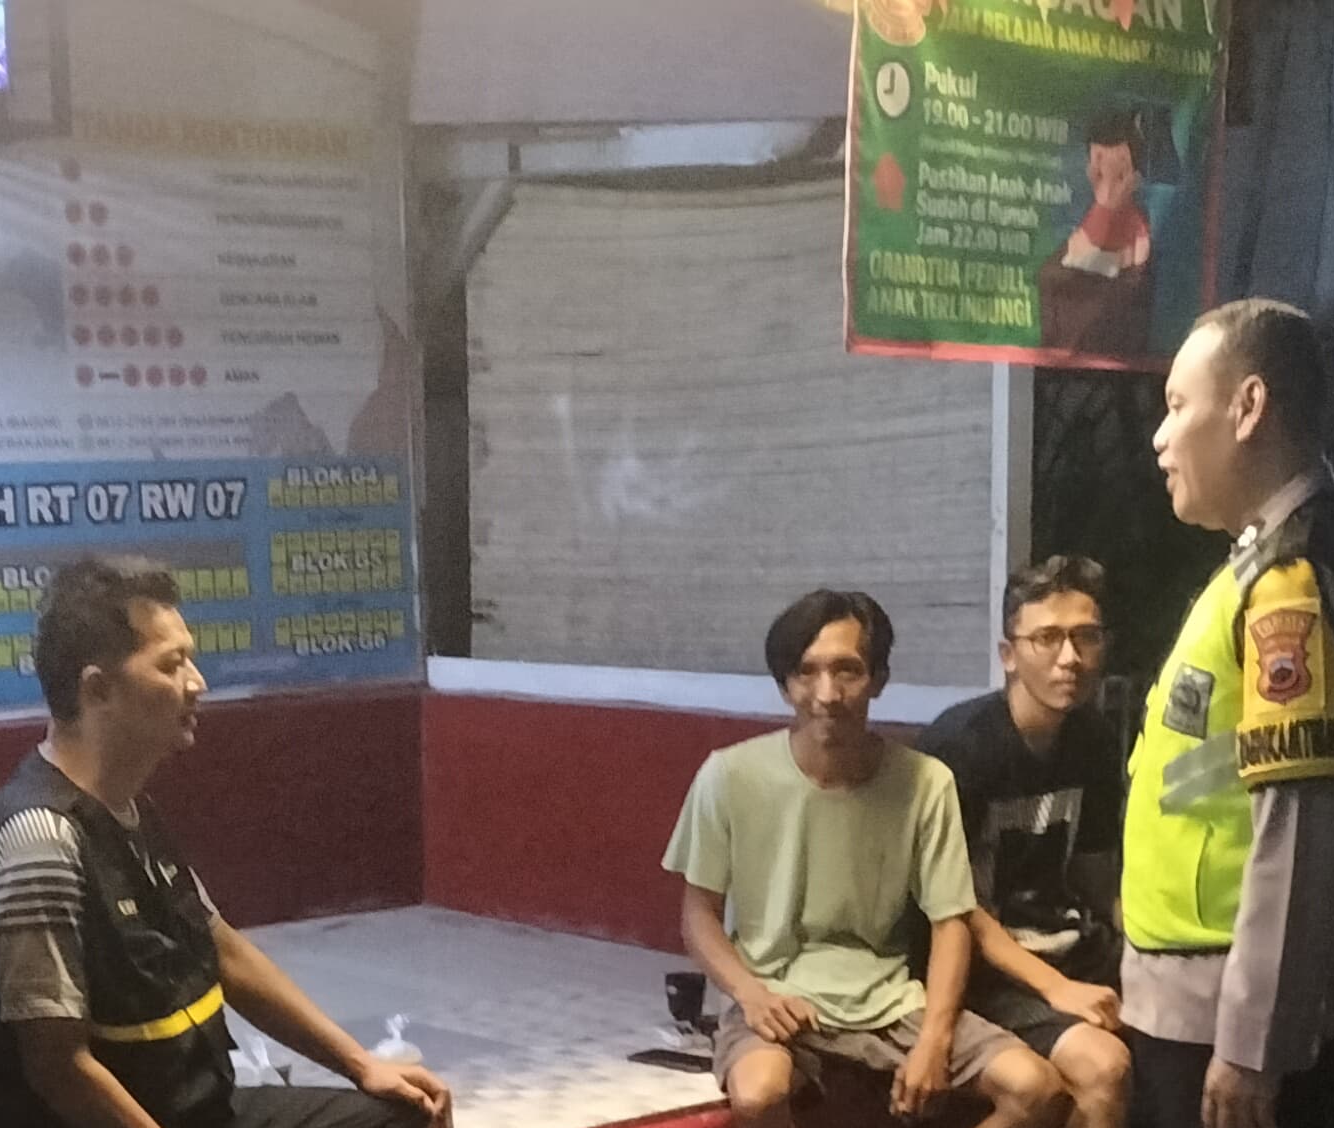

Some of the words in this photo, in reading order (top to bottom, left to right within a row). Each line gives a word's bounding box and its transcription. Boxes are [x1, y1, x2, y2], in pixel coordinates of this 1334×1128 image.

[982, 8, 1055, 49] BELAJAR
[924, 61, 979, 99] Pukul
[984, 108, 1033, 140] 21.00
[916, 221, 950, 246] Jam
[867, 283, 916, 318] ANAK
[26, 483, 76, 526] RT
[85, 481, 129, 523] 07
[139, 478, 195, 522] RW
[204, 477, 246, 519] 07
